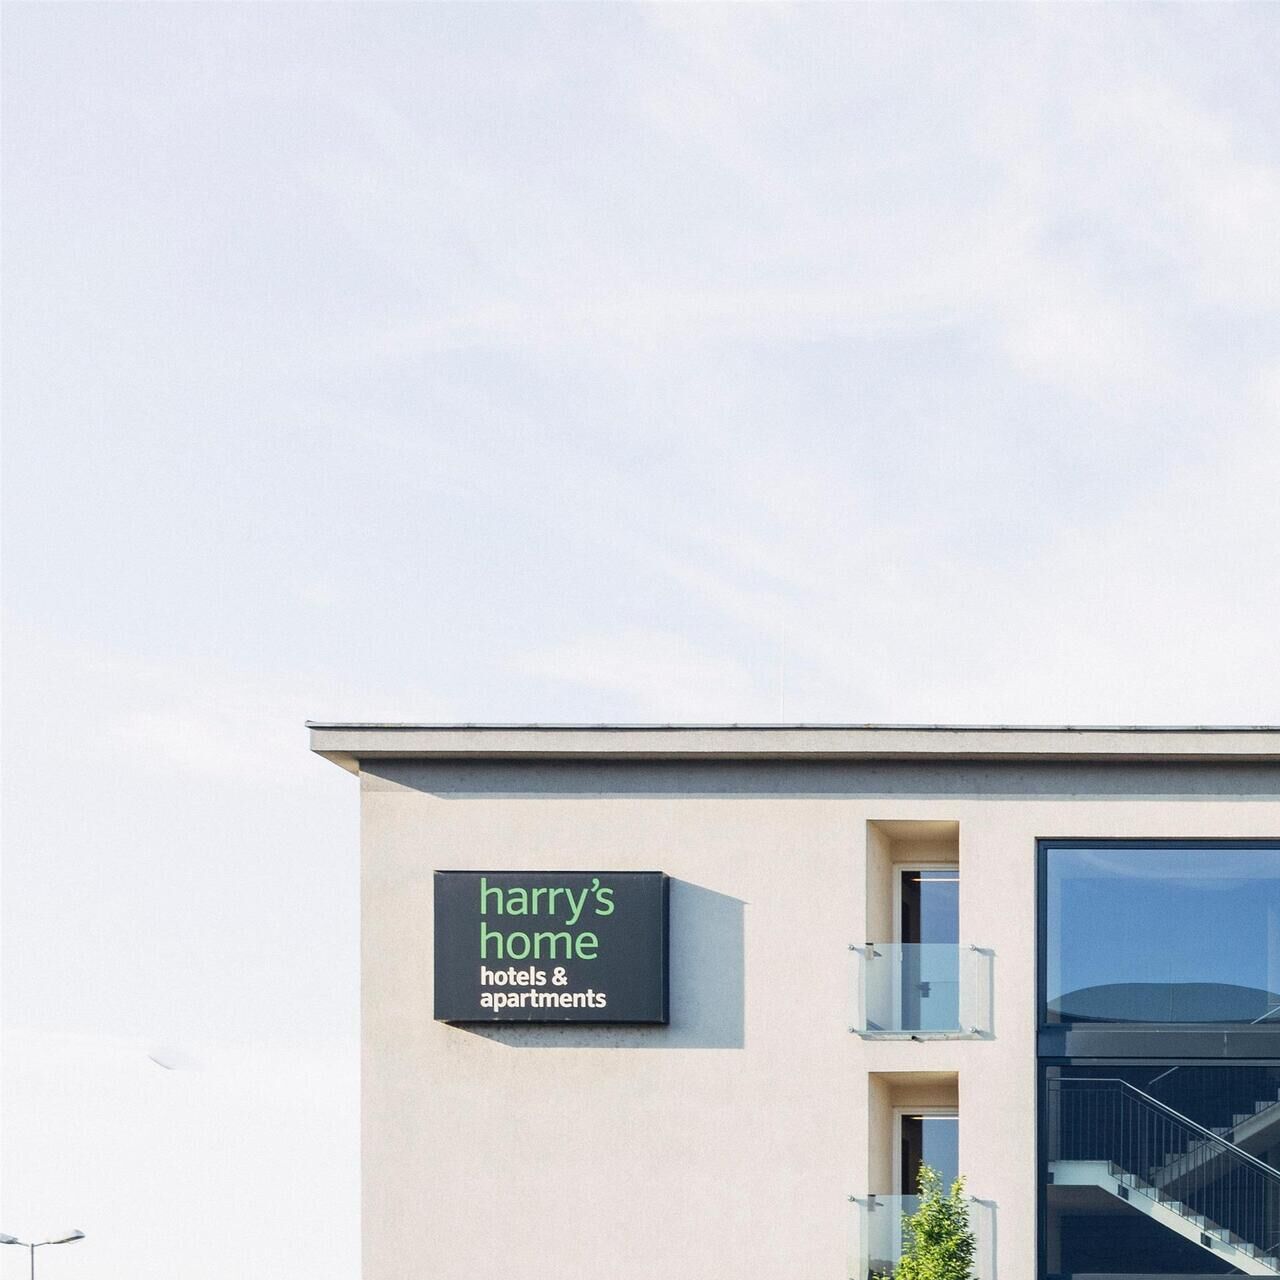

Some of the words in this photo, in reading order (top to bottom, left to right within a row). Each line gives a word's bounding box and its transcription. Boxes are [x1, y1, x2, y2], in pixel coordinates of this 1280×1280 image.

[480, 877, 615, 926] harry’s
[480, 922, 599, 960] home
[480, 966, 547, 986] hotels
[552, 966, 568, 986] &
[480, 989, 607, 1013] apartments
